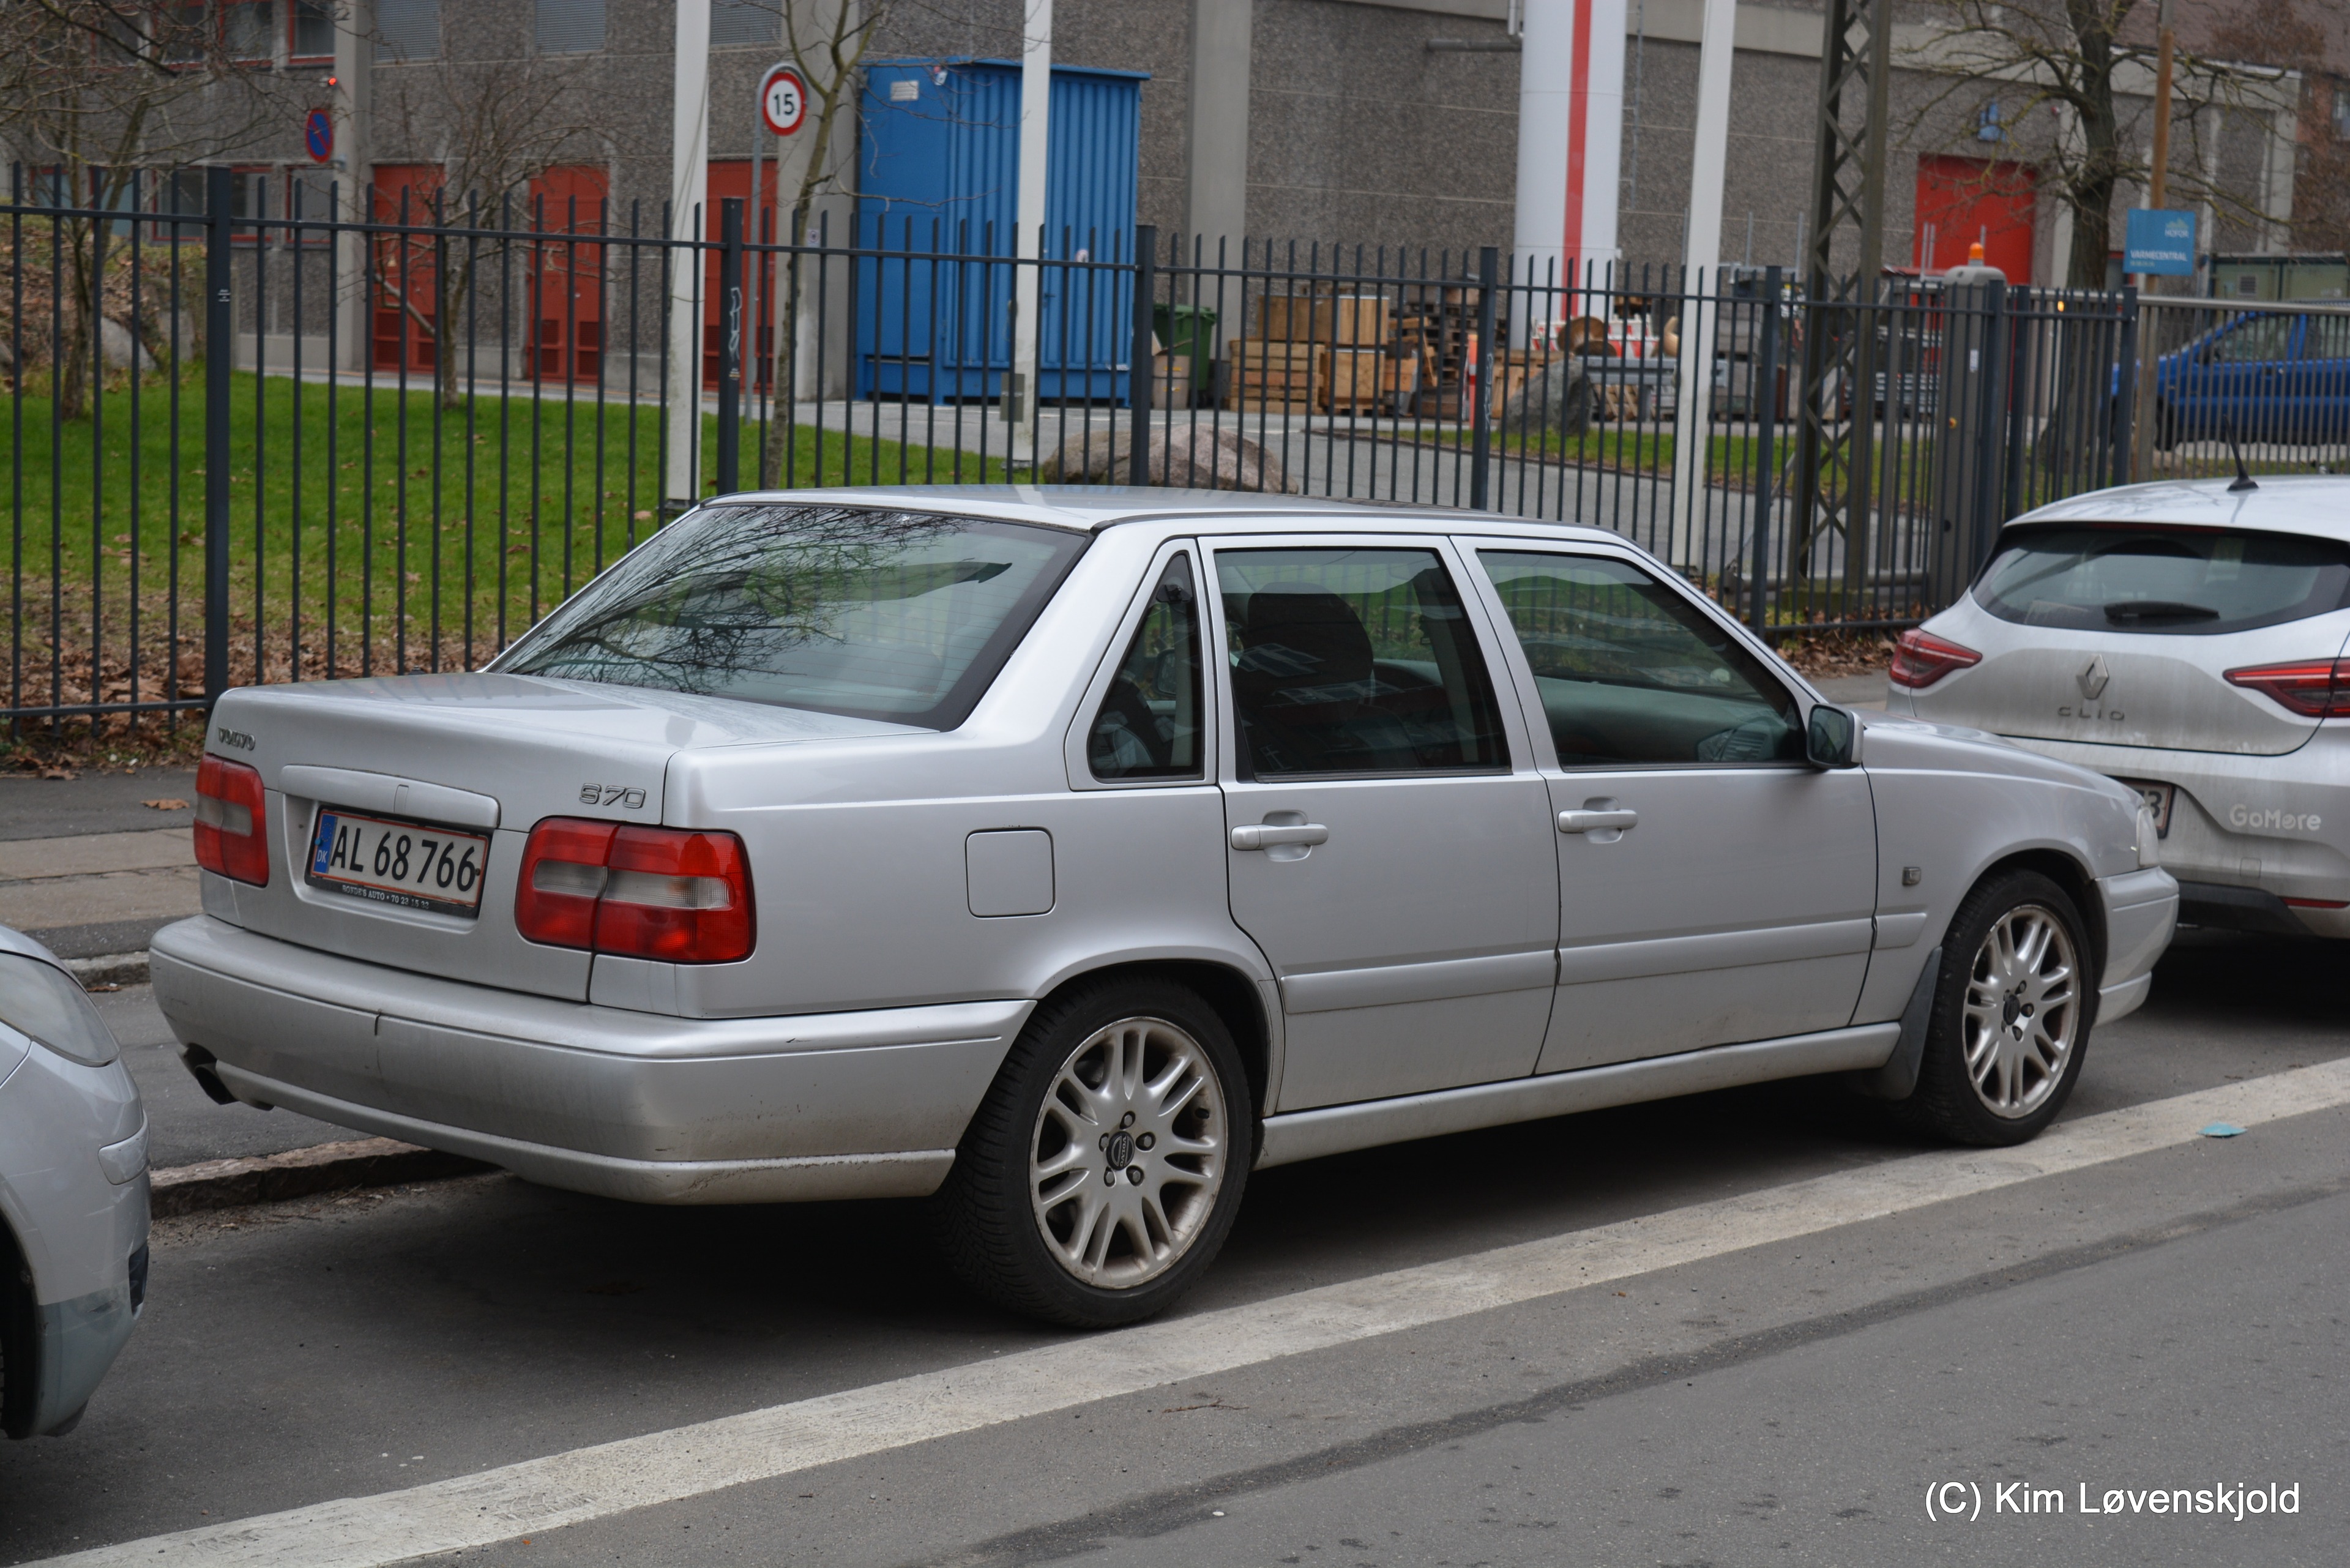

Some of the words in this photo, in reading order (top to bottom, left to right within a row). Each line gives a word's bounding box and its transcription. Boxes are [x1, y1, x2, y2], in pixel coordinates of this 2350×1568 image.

[774, 94, 794, 116] 15
[2057, 706, 2125, 721] CLIO
[218, 726, 256, 751] VOLVO
[2229, 803, 2321, 832] GoMore
[316, 849, 328, 864] DK
[330, 825, 364, 873] AL
[374, 831, 411, 881] 68
[417, 838, 476, 892] 766
[368, 890, 385, 900] AUTO
[391, 894, 400, 903] 70
